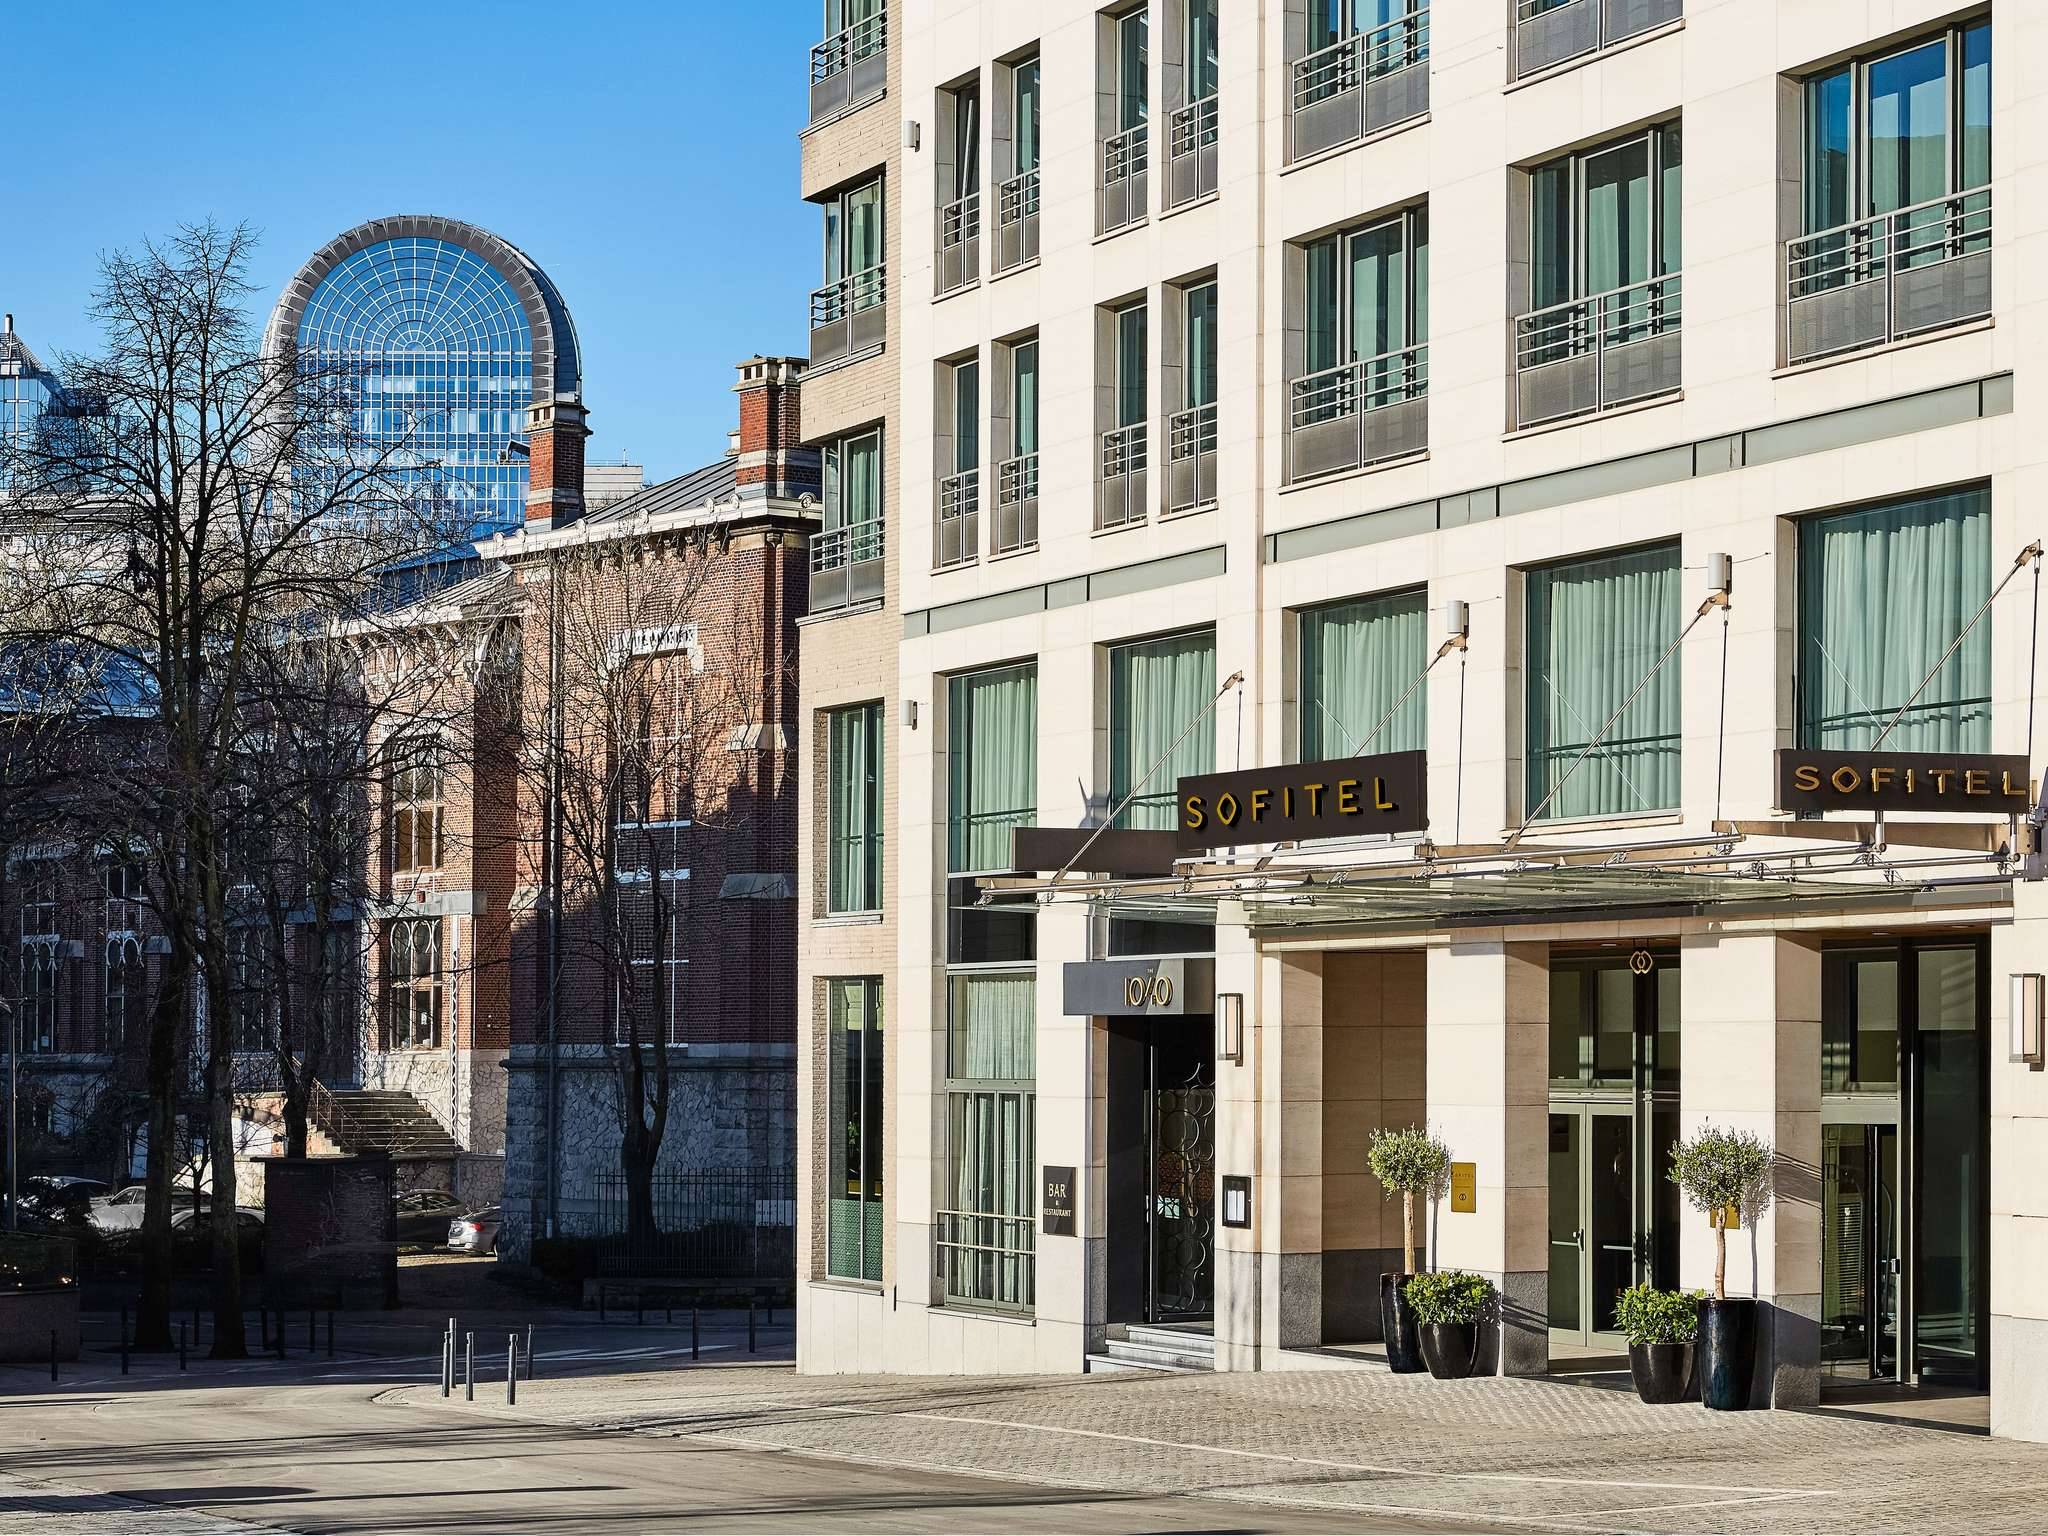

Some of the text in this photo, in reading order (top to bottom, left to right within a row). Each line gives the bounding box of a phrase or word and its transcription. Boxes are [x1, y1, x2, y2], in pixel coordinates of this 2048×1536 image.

[1794, 765, 2027, 796] SOFITEL
[1186, 776, 1395, 829] SOFITEL
[1048, 1183, 1066, 1198] BAR
[1043, 1208, 1072, 1217] RESTAURANT
